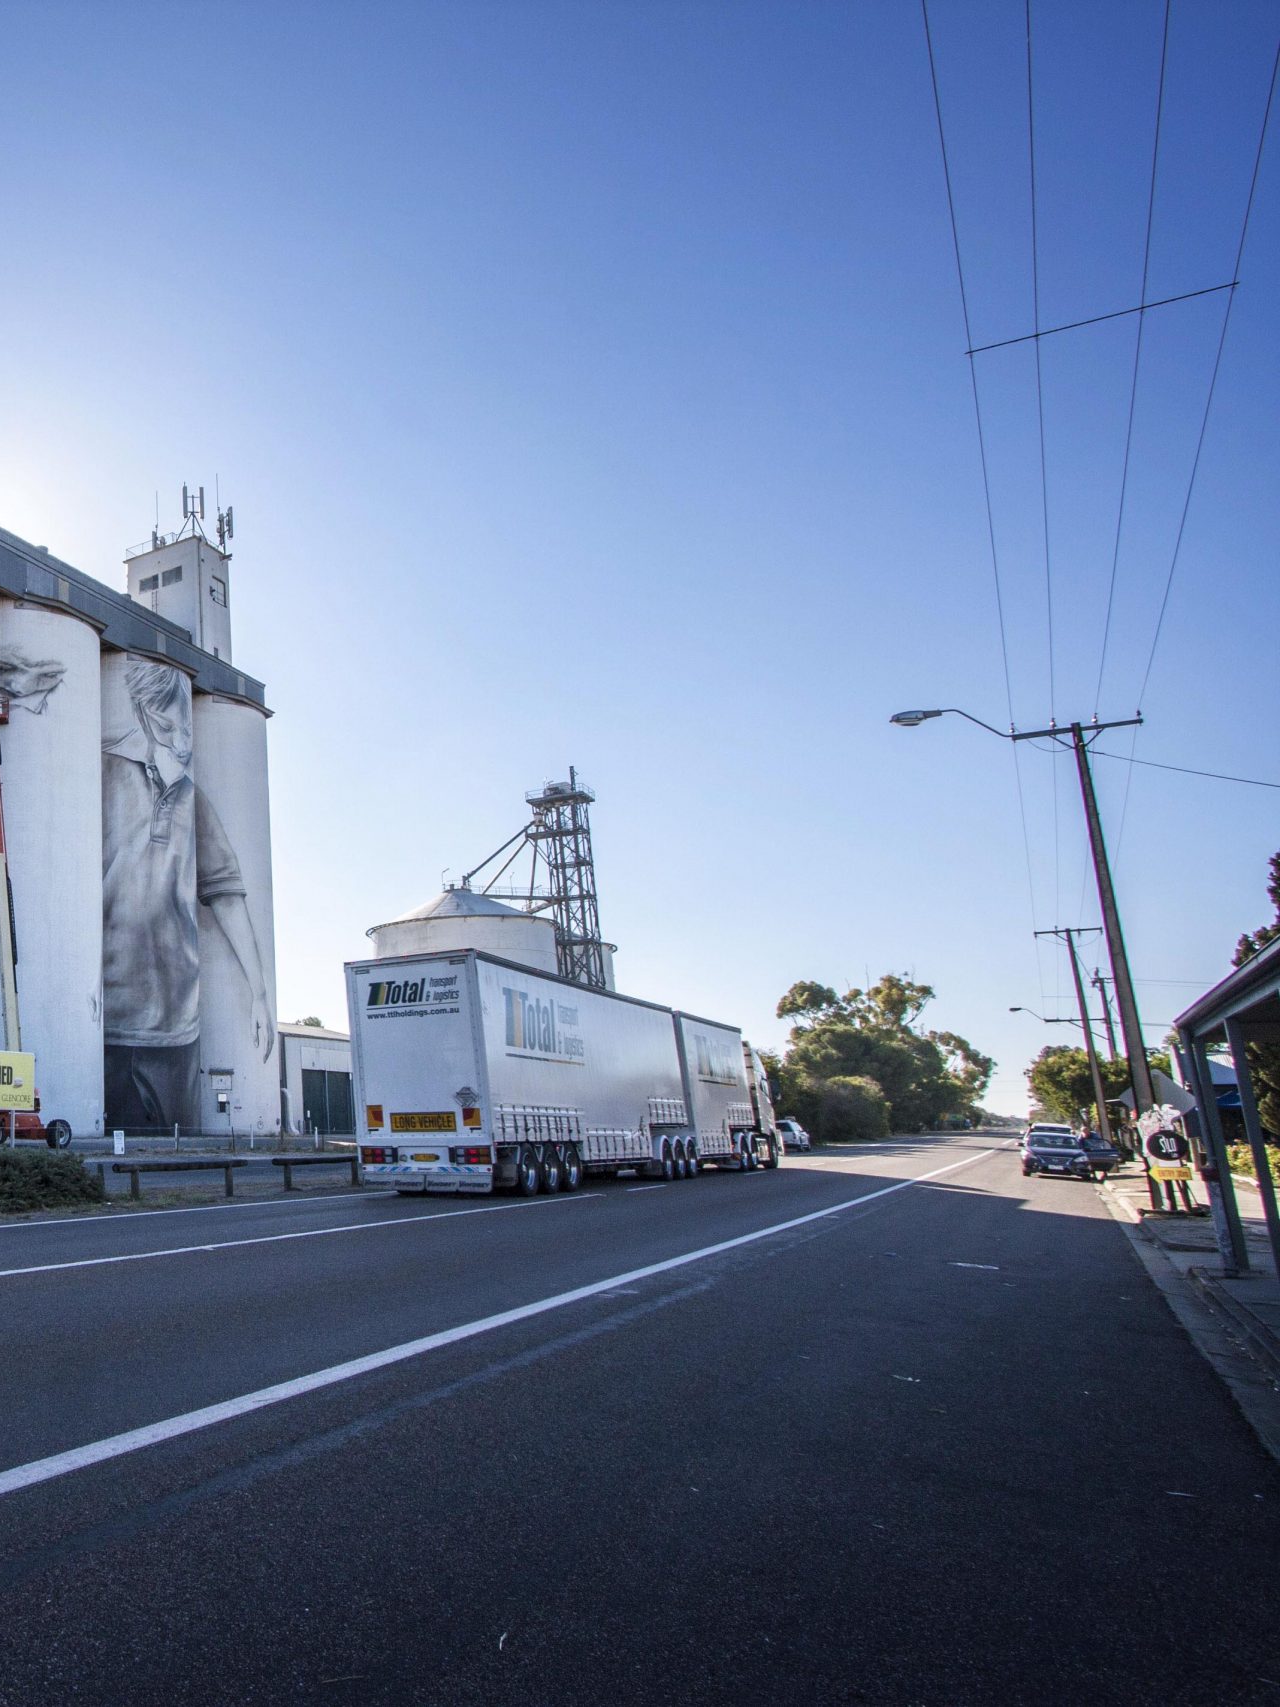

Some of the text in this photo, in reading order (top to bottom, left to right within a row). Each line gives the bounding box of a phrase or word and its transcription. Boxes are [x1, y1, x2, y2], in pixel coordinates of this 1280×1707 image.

[429, 974, 458, 988] transport
[384, 978, 426, 1005] Total
[433, 989, 460, 1003] logistics
[519, 989, 557, 1053] Total
[394, 1115, 453, 1129] LONG VEHICLE
